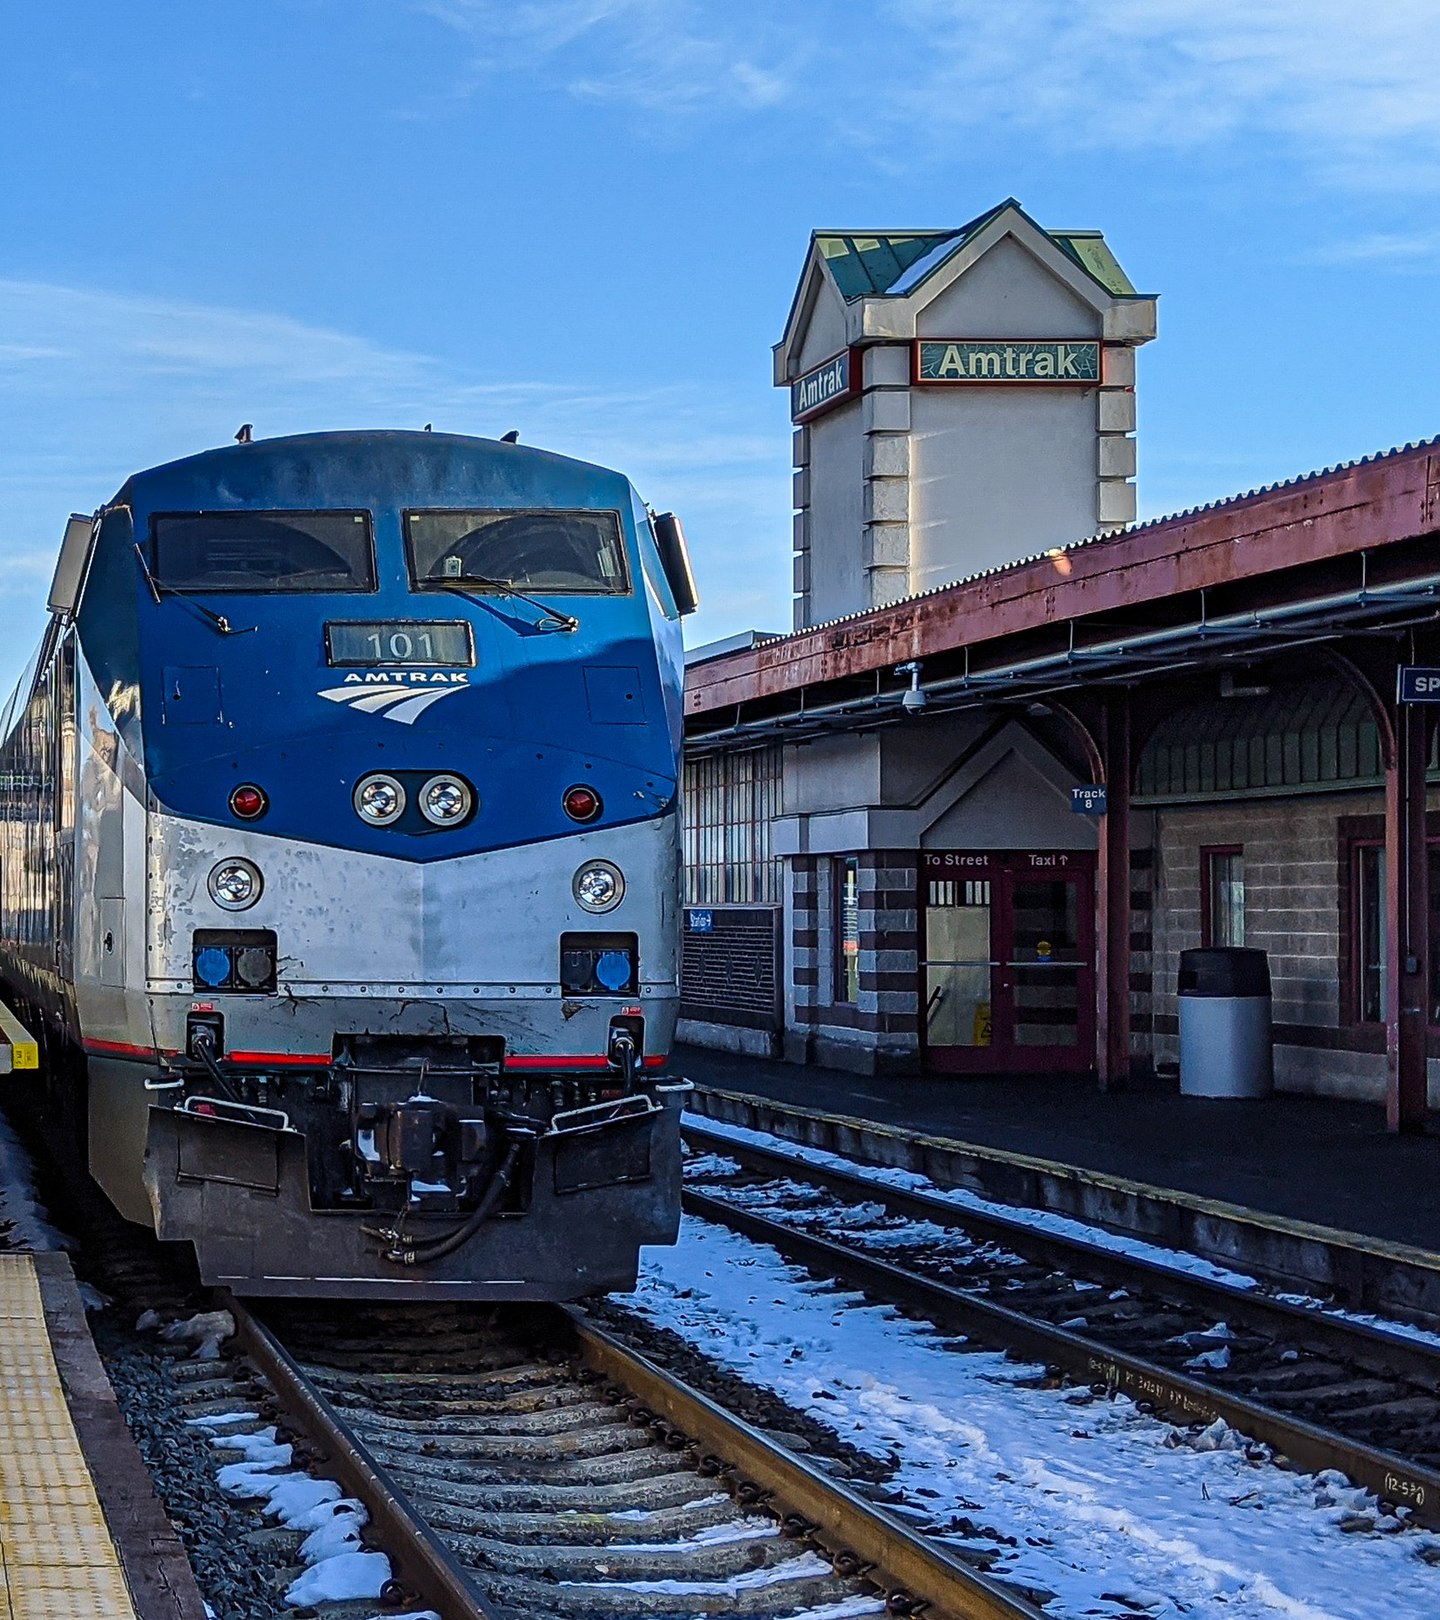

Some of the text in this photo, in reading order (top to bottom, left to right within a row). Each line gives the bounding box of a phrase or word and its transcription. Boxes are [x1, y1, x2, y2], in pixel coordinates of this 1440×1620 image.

[938, 345, 1079, 376] Amtrak
[799, 360, 843, 410] Amtrak
[367, 633, 433, 658] 101
[344, 673, 468, 682] AMTRAK
[1071, 788, 1106, 799] Track
[1085, 799, 1093, 809] 8
[924, 853, 989, 866] To Street
[1028, 854, 1056, 866] Taxi
